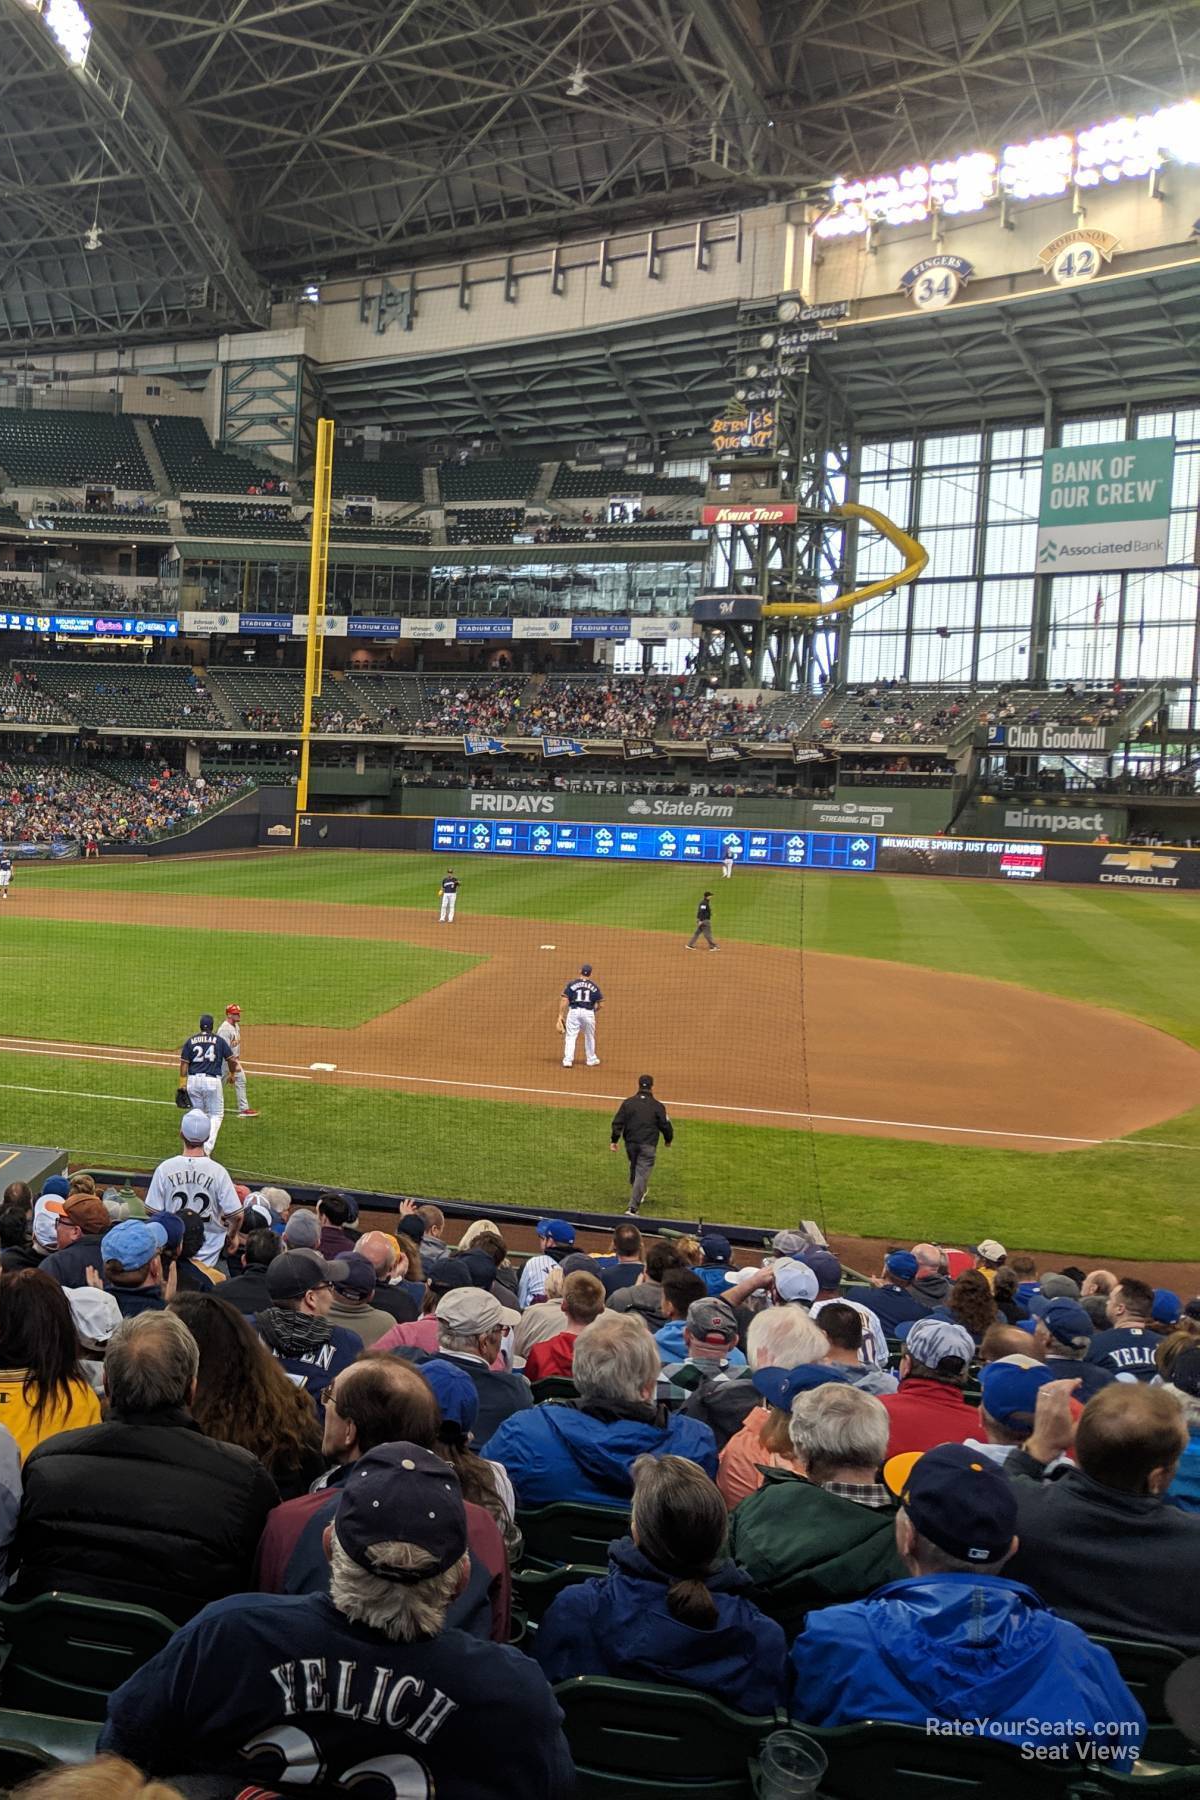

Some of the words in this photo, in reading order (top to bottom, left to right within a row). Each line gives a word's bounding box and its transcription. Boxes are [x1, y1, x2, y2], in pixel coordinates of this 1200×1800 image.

[1049, 230, 1108, 254] ROBINSON
[912, 256, 962, 276] FINGERS
[1058, 249, 1095, 278] 42
[918, 273, 951, 303] 34
[1051, 458, 1104, 485] BANK
[1109, 455, 1137, 479] OF
[1050, 485, 1090, 510] OUR
[240, 620, 272, 628] STADIUM
[1007, 726, 1038, 748] Club
[1042, 726, 1106, 749] Goodwill
[470, 793, 555, 813] FRIDAYS
[820, 815, 859, 824] STREAMING
[860, 816, 870, 824] ON
[1022, 808, 1104, 832] impact
[882, 838, 930, 849] MILWAUKEE
[931, 841, 963, 851] SPORTS
[965, 842, 984, 852] JUST
[986, 843, 1003, 853] GOT
[1005, 844, 1044, 855] LOUDER
[1099, 873, 1180, 886] CHEVROLET
[575, 989, 591, 1002] 11
[190, 1035, 217, 1045] AGUILAR
[192, 1045, 216, 1062] 24
[167, 1171, 214, 1190] YELICH
[171, 1191, 212, 1223] 22
[270, 1656, 460, 1745] YELICH
